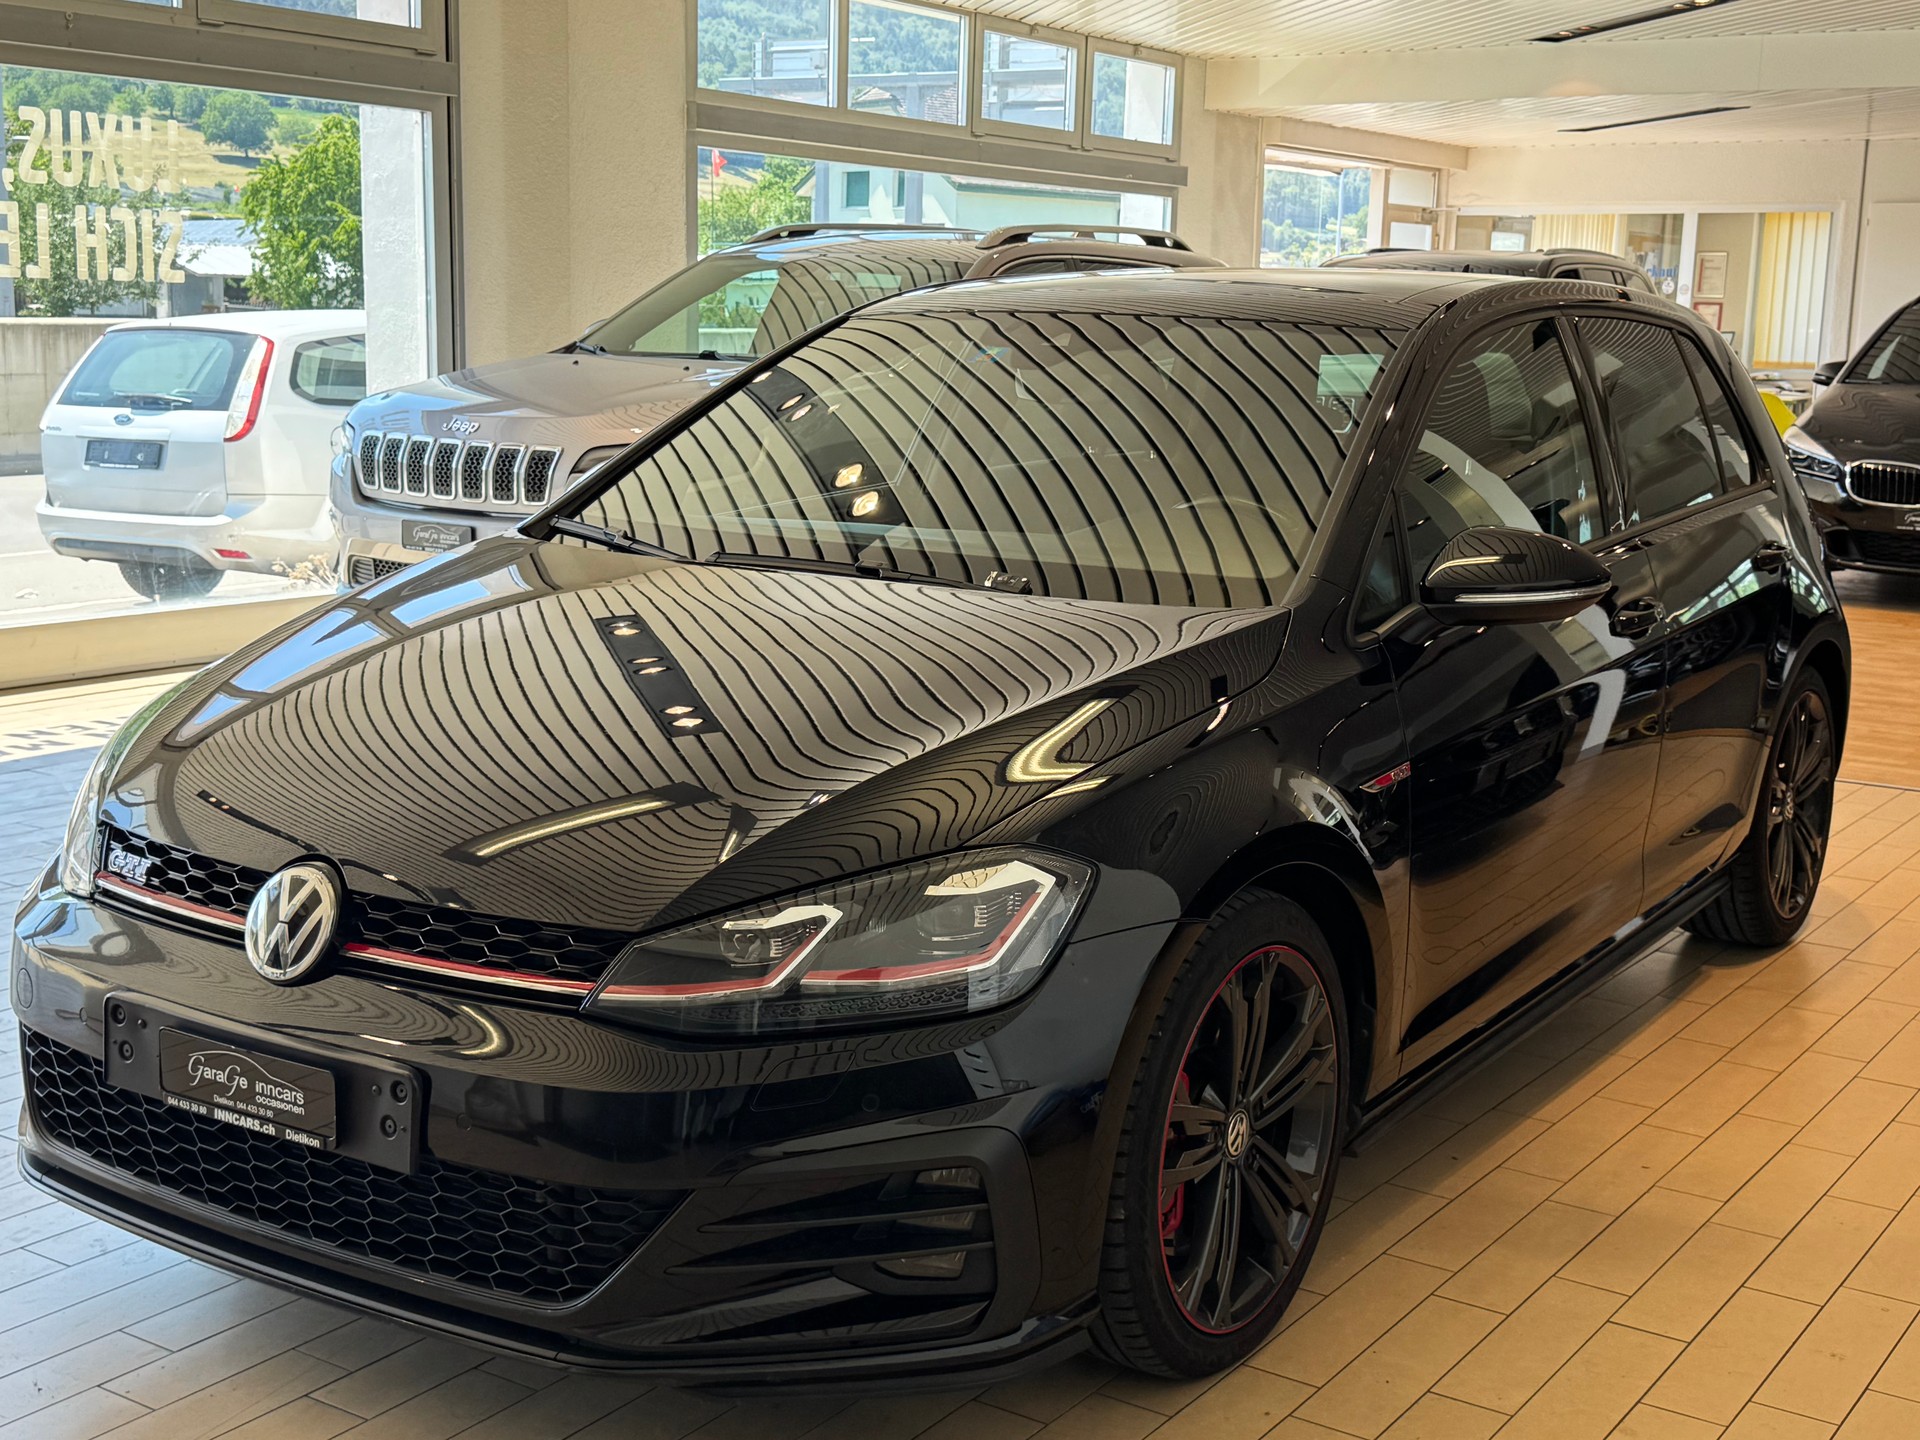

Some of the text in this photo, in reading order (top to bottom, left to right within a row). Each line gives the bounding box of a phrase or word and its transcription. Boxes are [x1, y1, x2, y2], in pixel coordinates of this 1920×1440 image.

[441, 417, 480, 436] Jeep
[108, 849, 152, 882] GTI
[188, 1055, 305, 1105] GaraGe inncars
[213, 1094, 235, 1106] Dietikon
[247, 1103, 258, 1114] 433
[258, 1106, 266, 1116] 30
[255, 1095, 305, 1116] occasionen
[179, 1099, 190, 1110] 433
[190, 1102, 199, 1113] 30
[214, 1108, 276, 1136] INNCARS.ch
[285, 1129, 320, 1149] Dietikon
